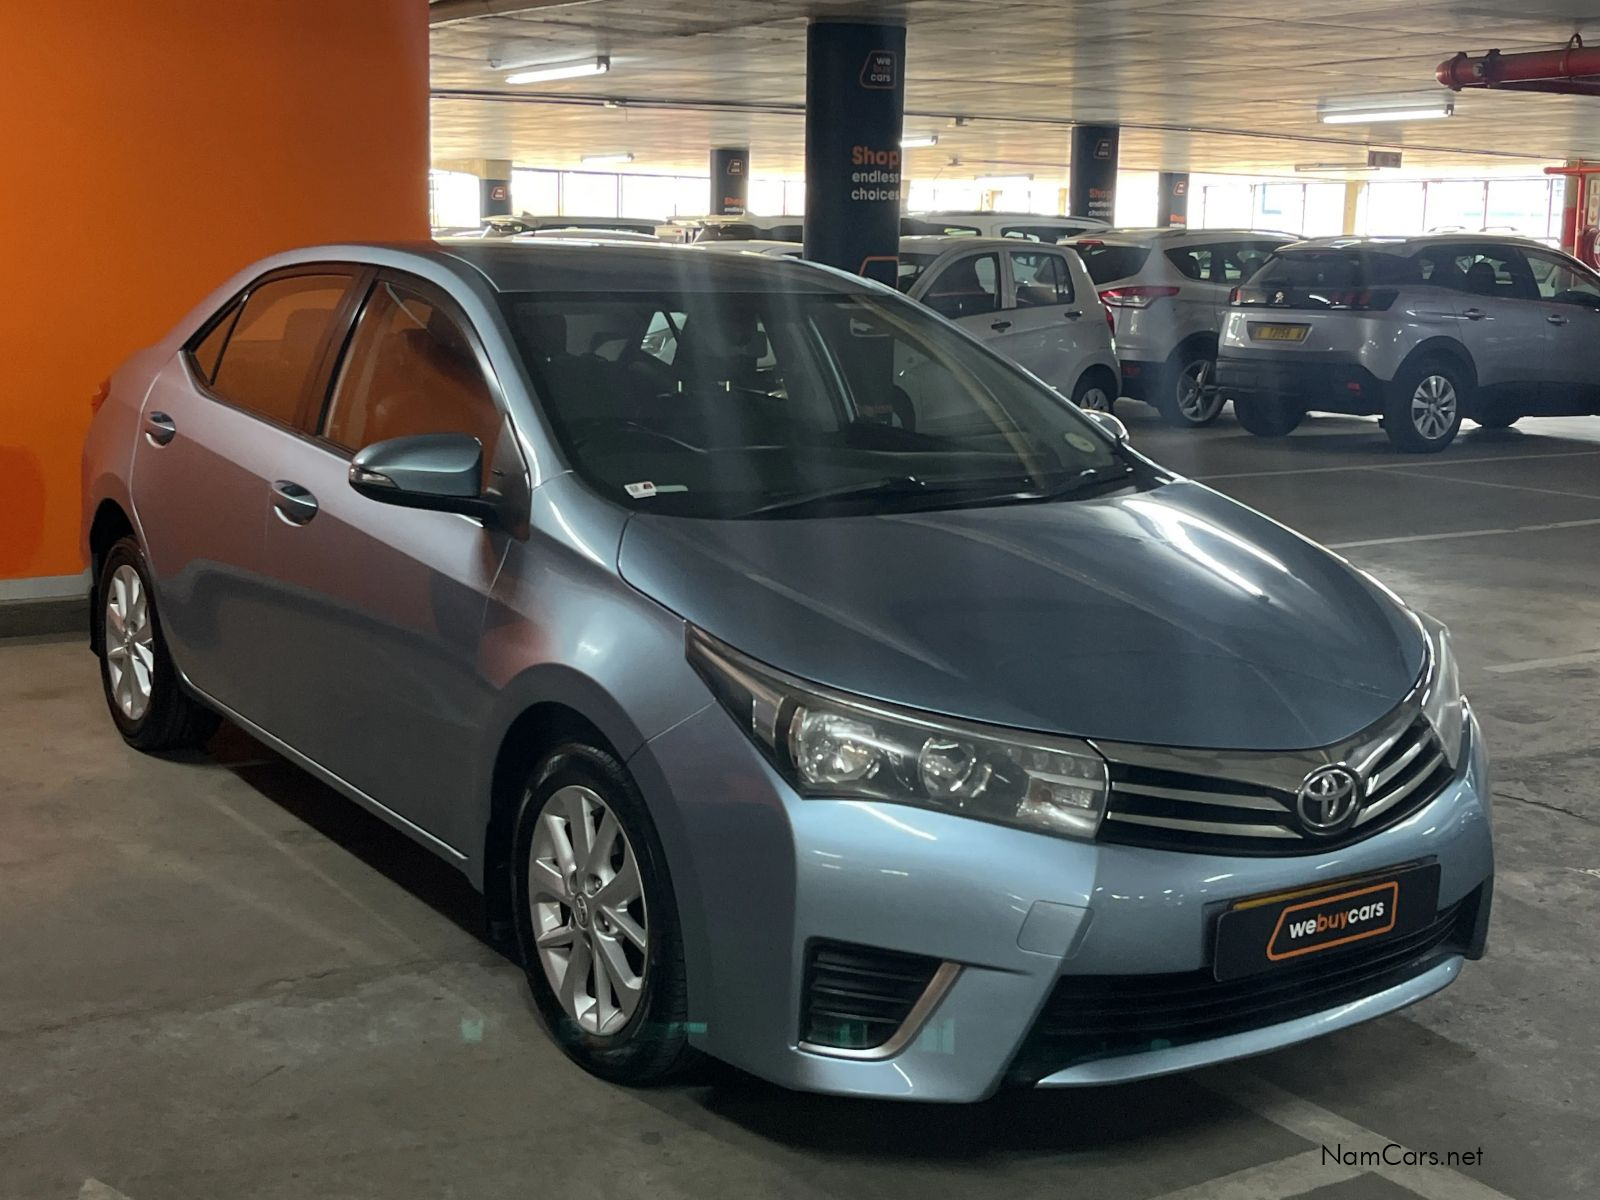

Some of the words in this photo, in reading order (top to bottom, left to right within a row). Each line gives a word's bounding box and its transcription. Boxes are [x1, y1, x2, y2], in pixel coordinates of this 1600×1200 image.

[870, 73, 891, 82] cars
[851, 145, 899, 169] Shop
[851, 170, 899, 183] endless
[1289, 901, 1385, 939] webuycars
